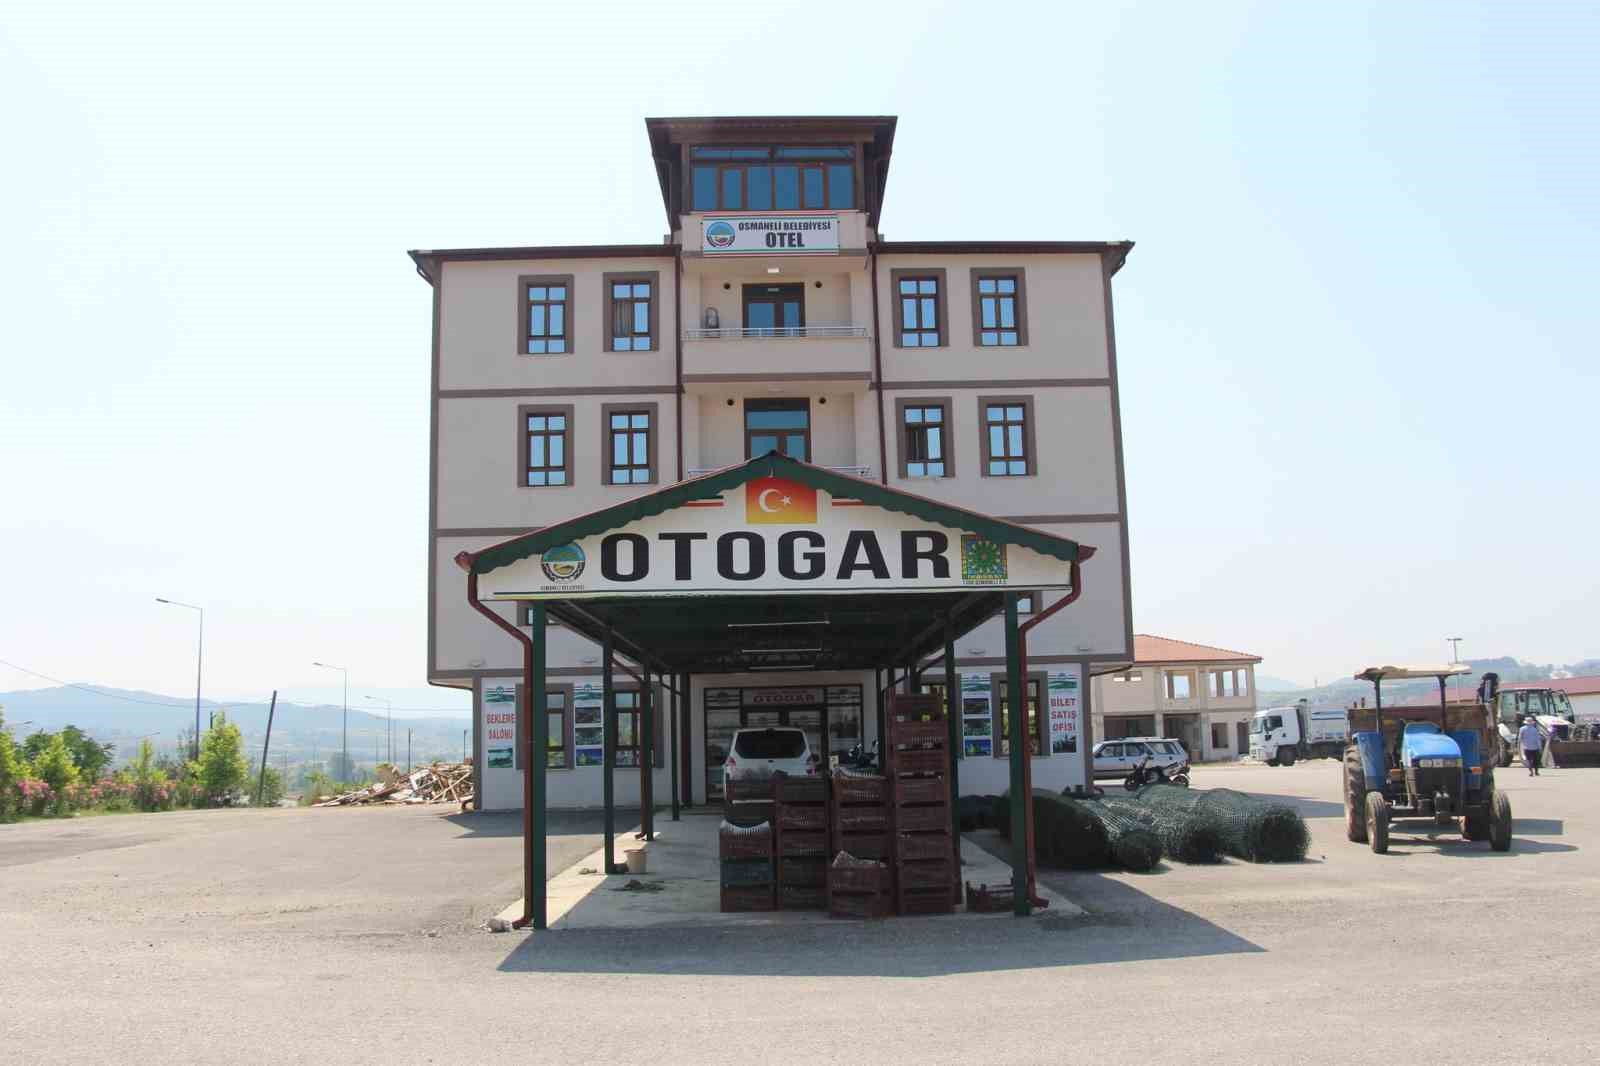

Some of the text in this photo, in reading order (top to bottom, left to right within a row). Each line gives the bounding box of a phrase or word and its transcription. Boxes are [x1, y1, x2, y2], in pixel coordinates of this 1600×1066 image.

[765, 232, 805, 248] OTEL
[600, 530, 951, 582] OTOGAR
[1051, 696, 1076, 707] BİLET
